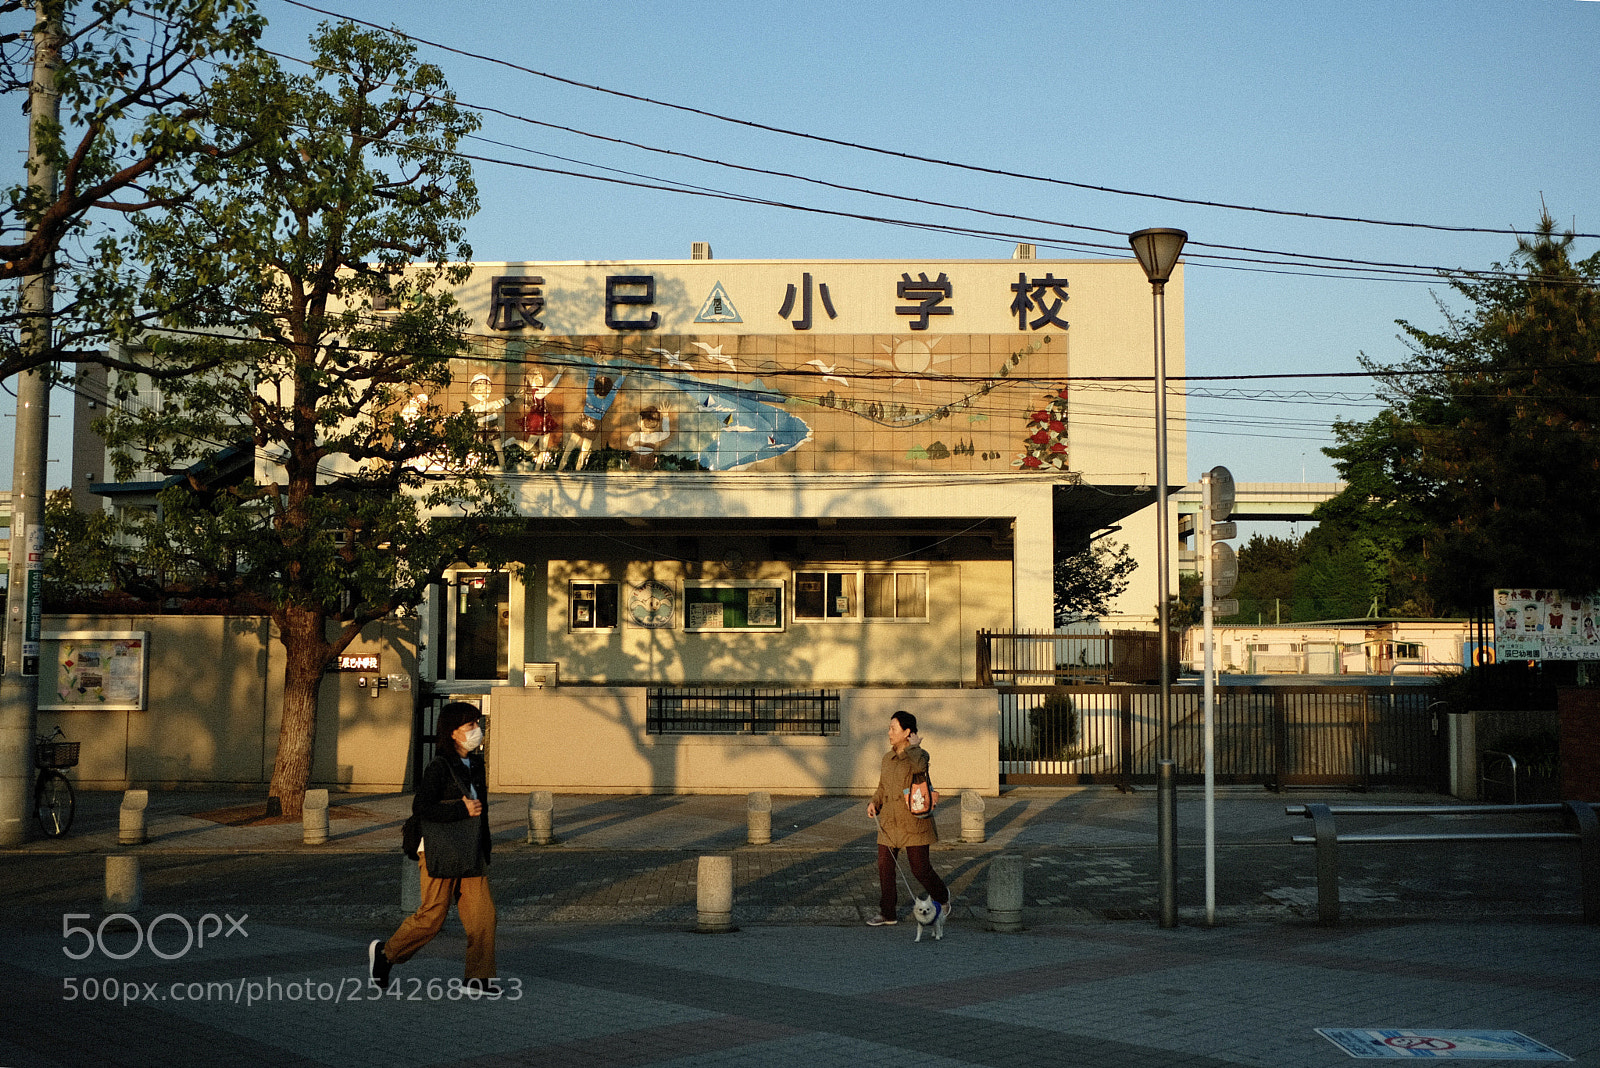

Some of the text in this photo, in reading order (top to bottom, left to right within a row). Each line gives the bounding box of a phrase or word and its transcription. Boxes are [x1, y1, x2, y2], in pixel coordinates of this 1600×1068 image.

[486, 271, 1070, 332] 辰巳小学校
[1504, 649, 1540, 658] 辰巳幼稚園
